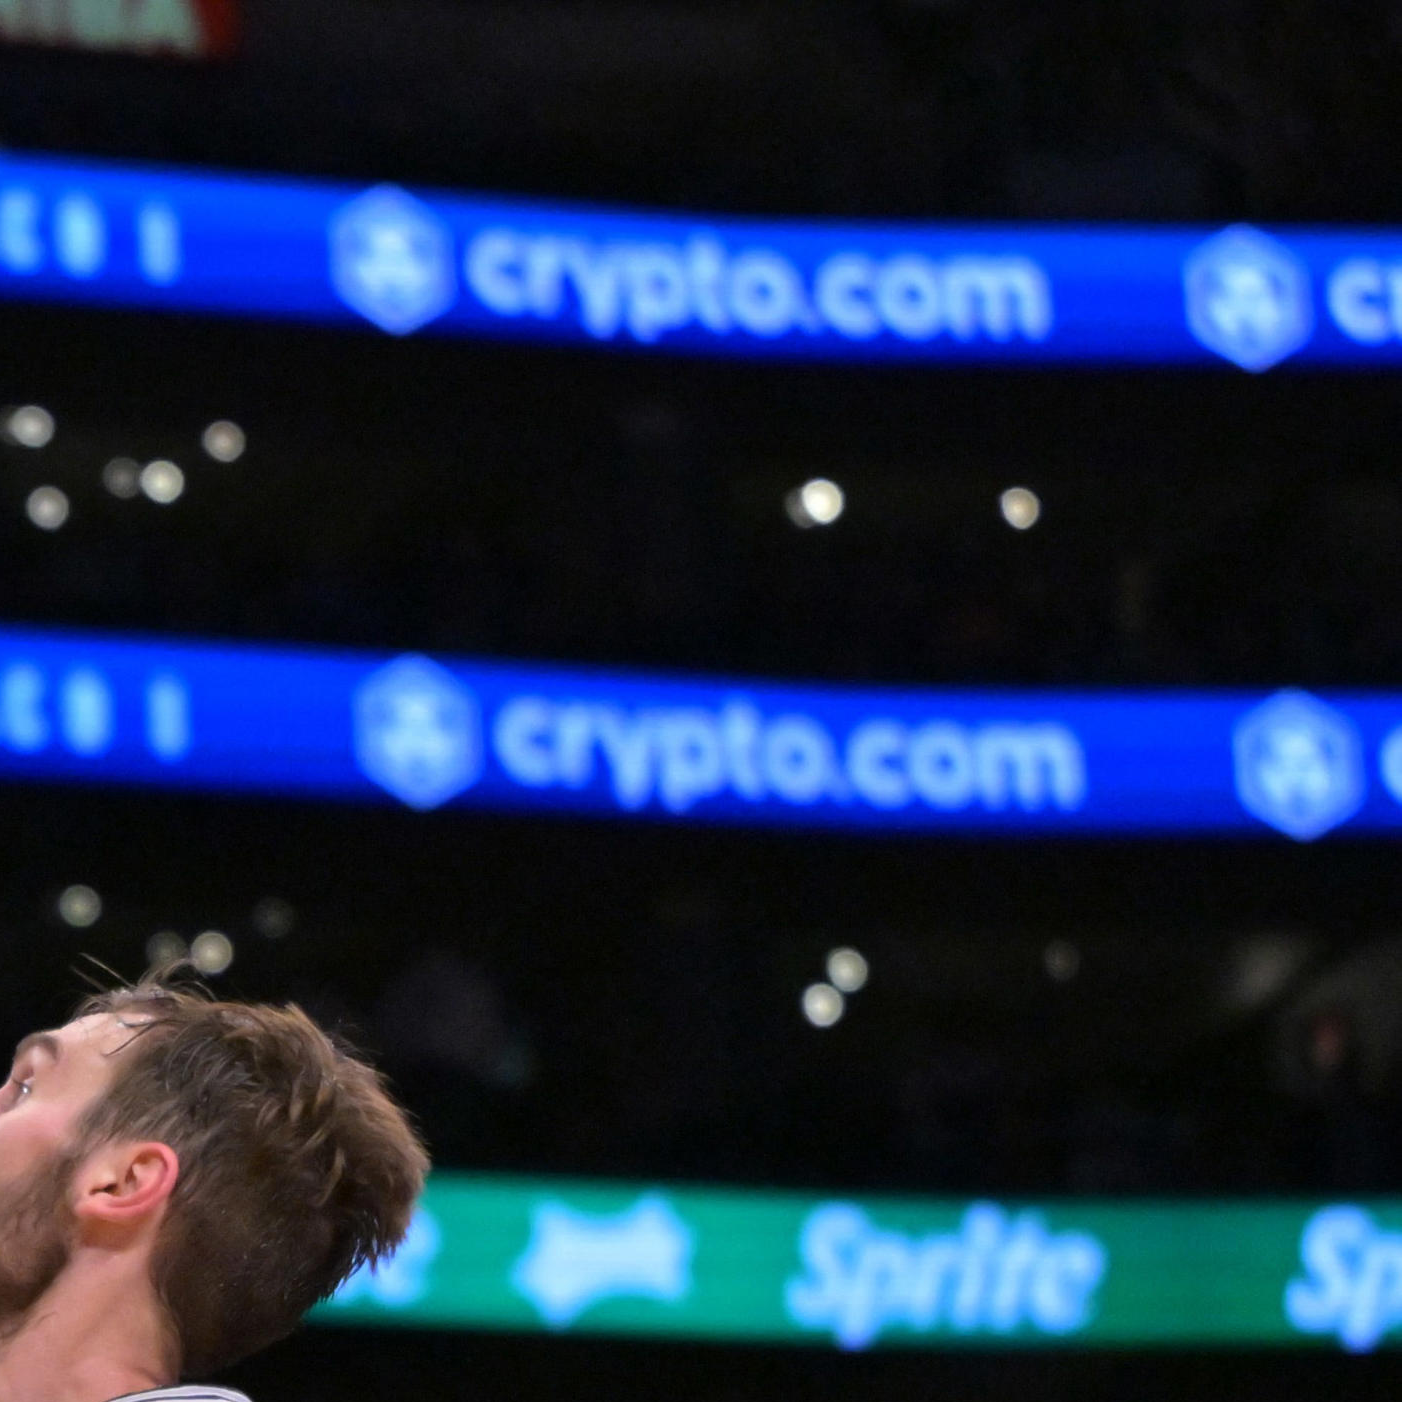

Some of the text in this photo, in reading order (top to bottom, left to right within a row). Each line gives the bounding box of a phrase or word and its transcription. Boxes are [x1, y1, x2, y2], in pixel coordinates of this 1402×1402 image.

[462, 226, 1054, 342] crypto.com
[494, 695, 1084, 813] crypto.com
[785, 1200, 1107, 1352] Sprite
